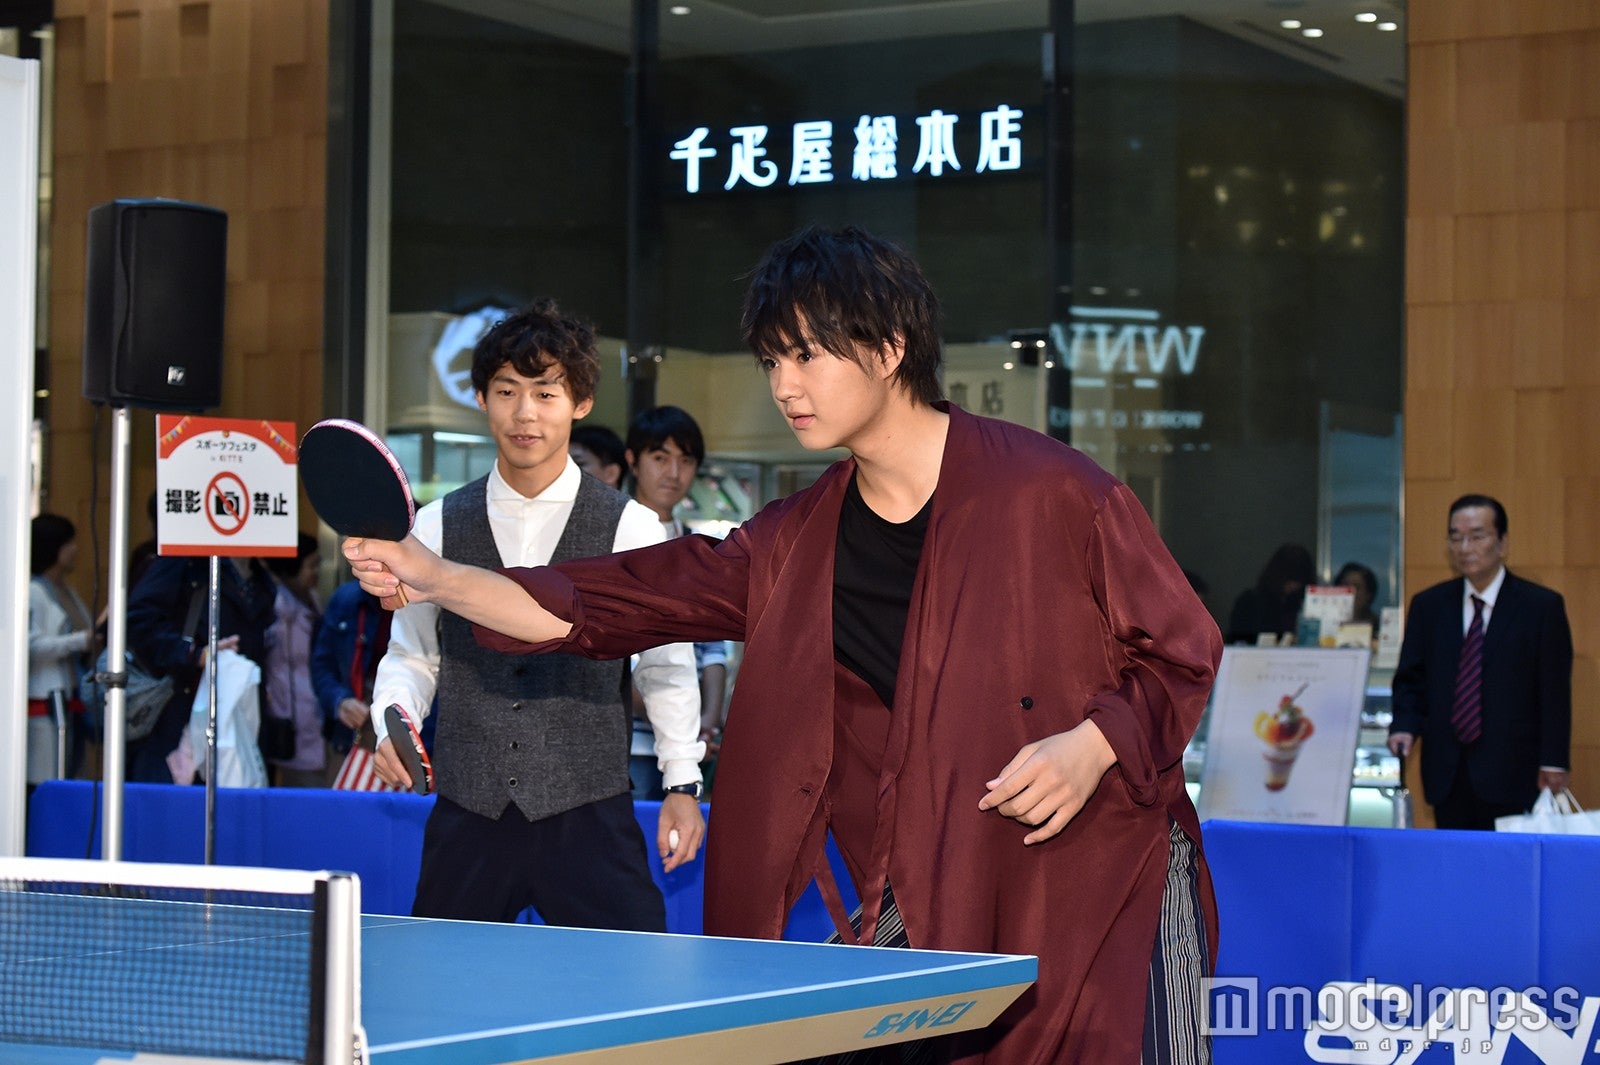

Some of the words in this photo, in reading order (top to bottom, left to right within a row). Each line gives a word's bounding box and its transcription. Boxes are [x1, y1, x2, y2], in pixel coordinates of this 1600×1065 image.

[669, 104, 1024, 193] 千疋屋総本店
[196, 440, 257, 451] スポーツフェスタ
[165, 488, 201, 514] 撮影
[253, 492, 288, 516] 禁止
[1304, 981, 1600, 1065] SAN
